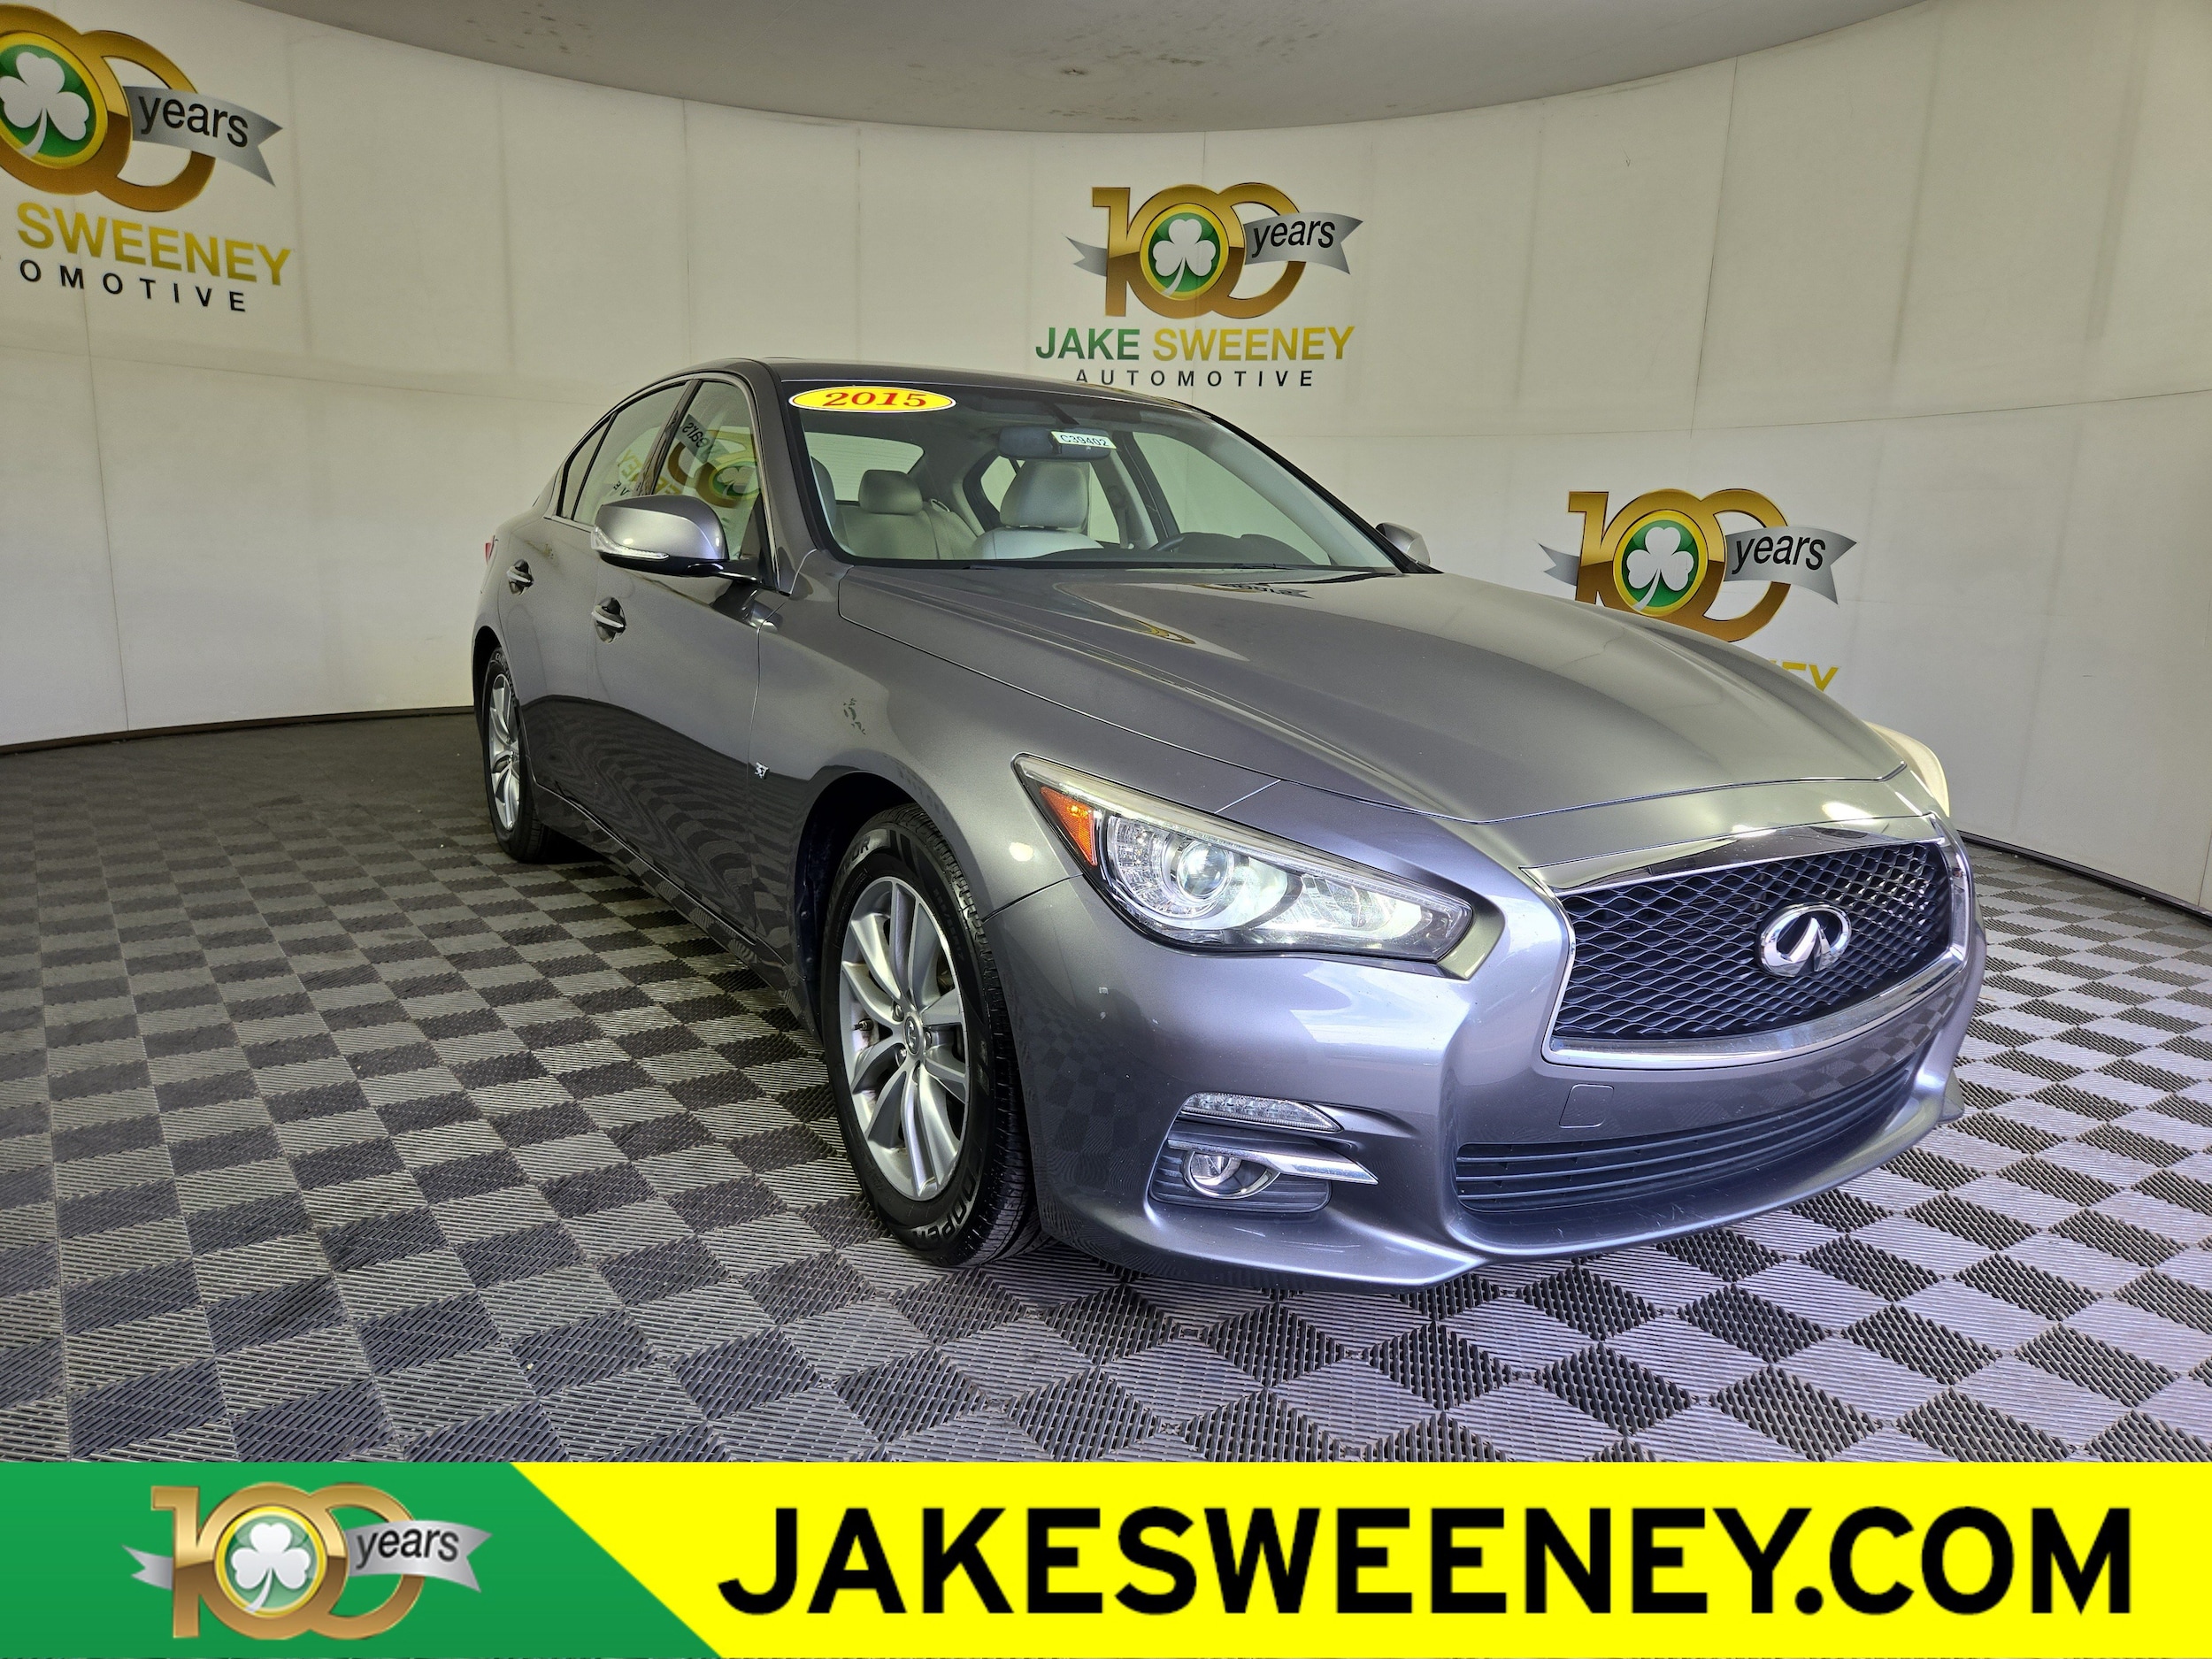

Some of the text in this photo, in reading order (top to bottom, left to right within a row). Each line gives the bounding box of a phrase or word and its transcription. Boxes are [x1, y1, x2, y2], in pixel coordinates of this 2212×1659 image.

[138, 96, 248, 148] years
[17, 202, 292, 286] SWEENEY
[1251, 219, 1336, 258] years
[1035, 326, 1356, 361] JAKE SWEENEY
[1076, 369, 1313, 387] AUTOMOTIVE
[823, 392, 927, 407] 2015
[1060, 434, 1110, 447] C39402
[1732, 535, 1826, 575] years
